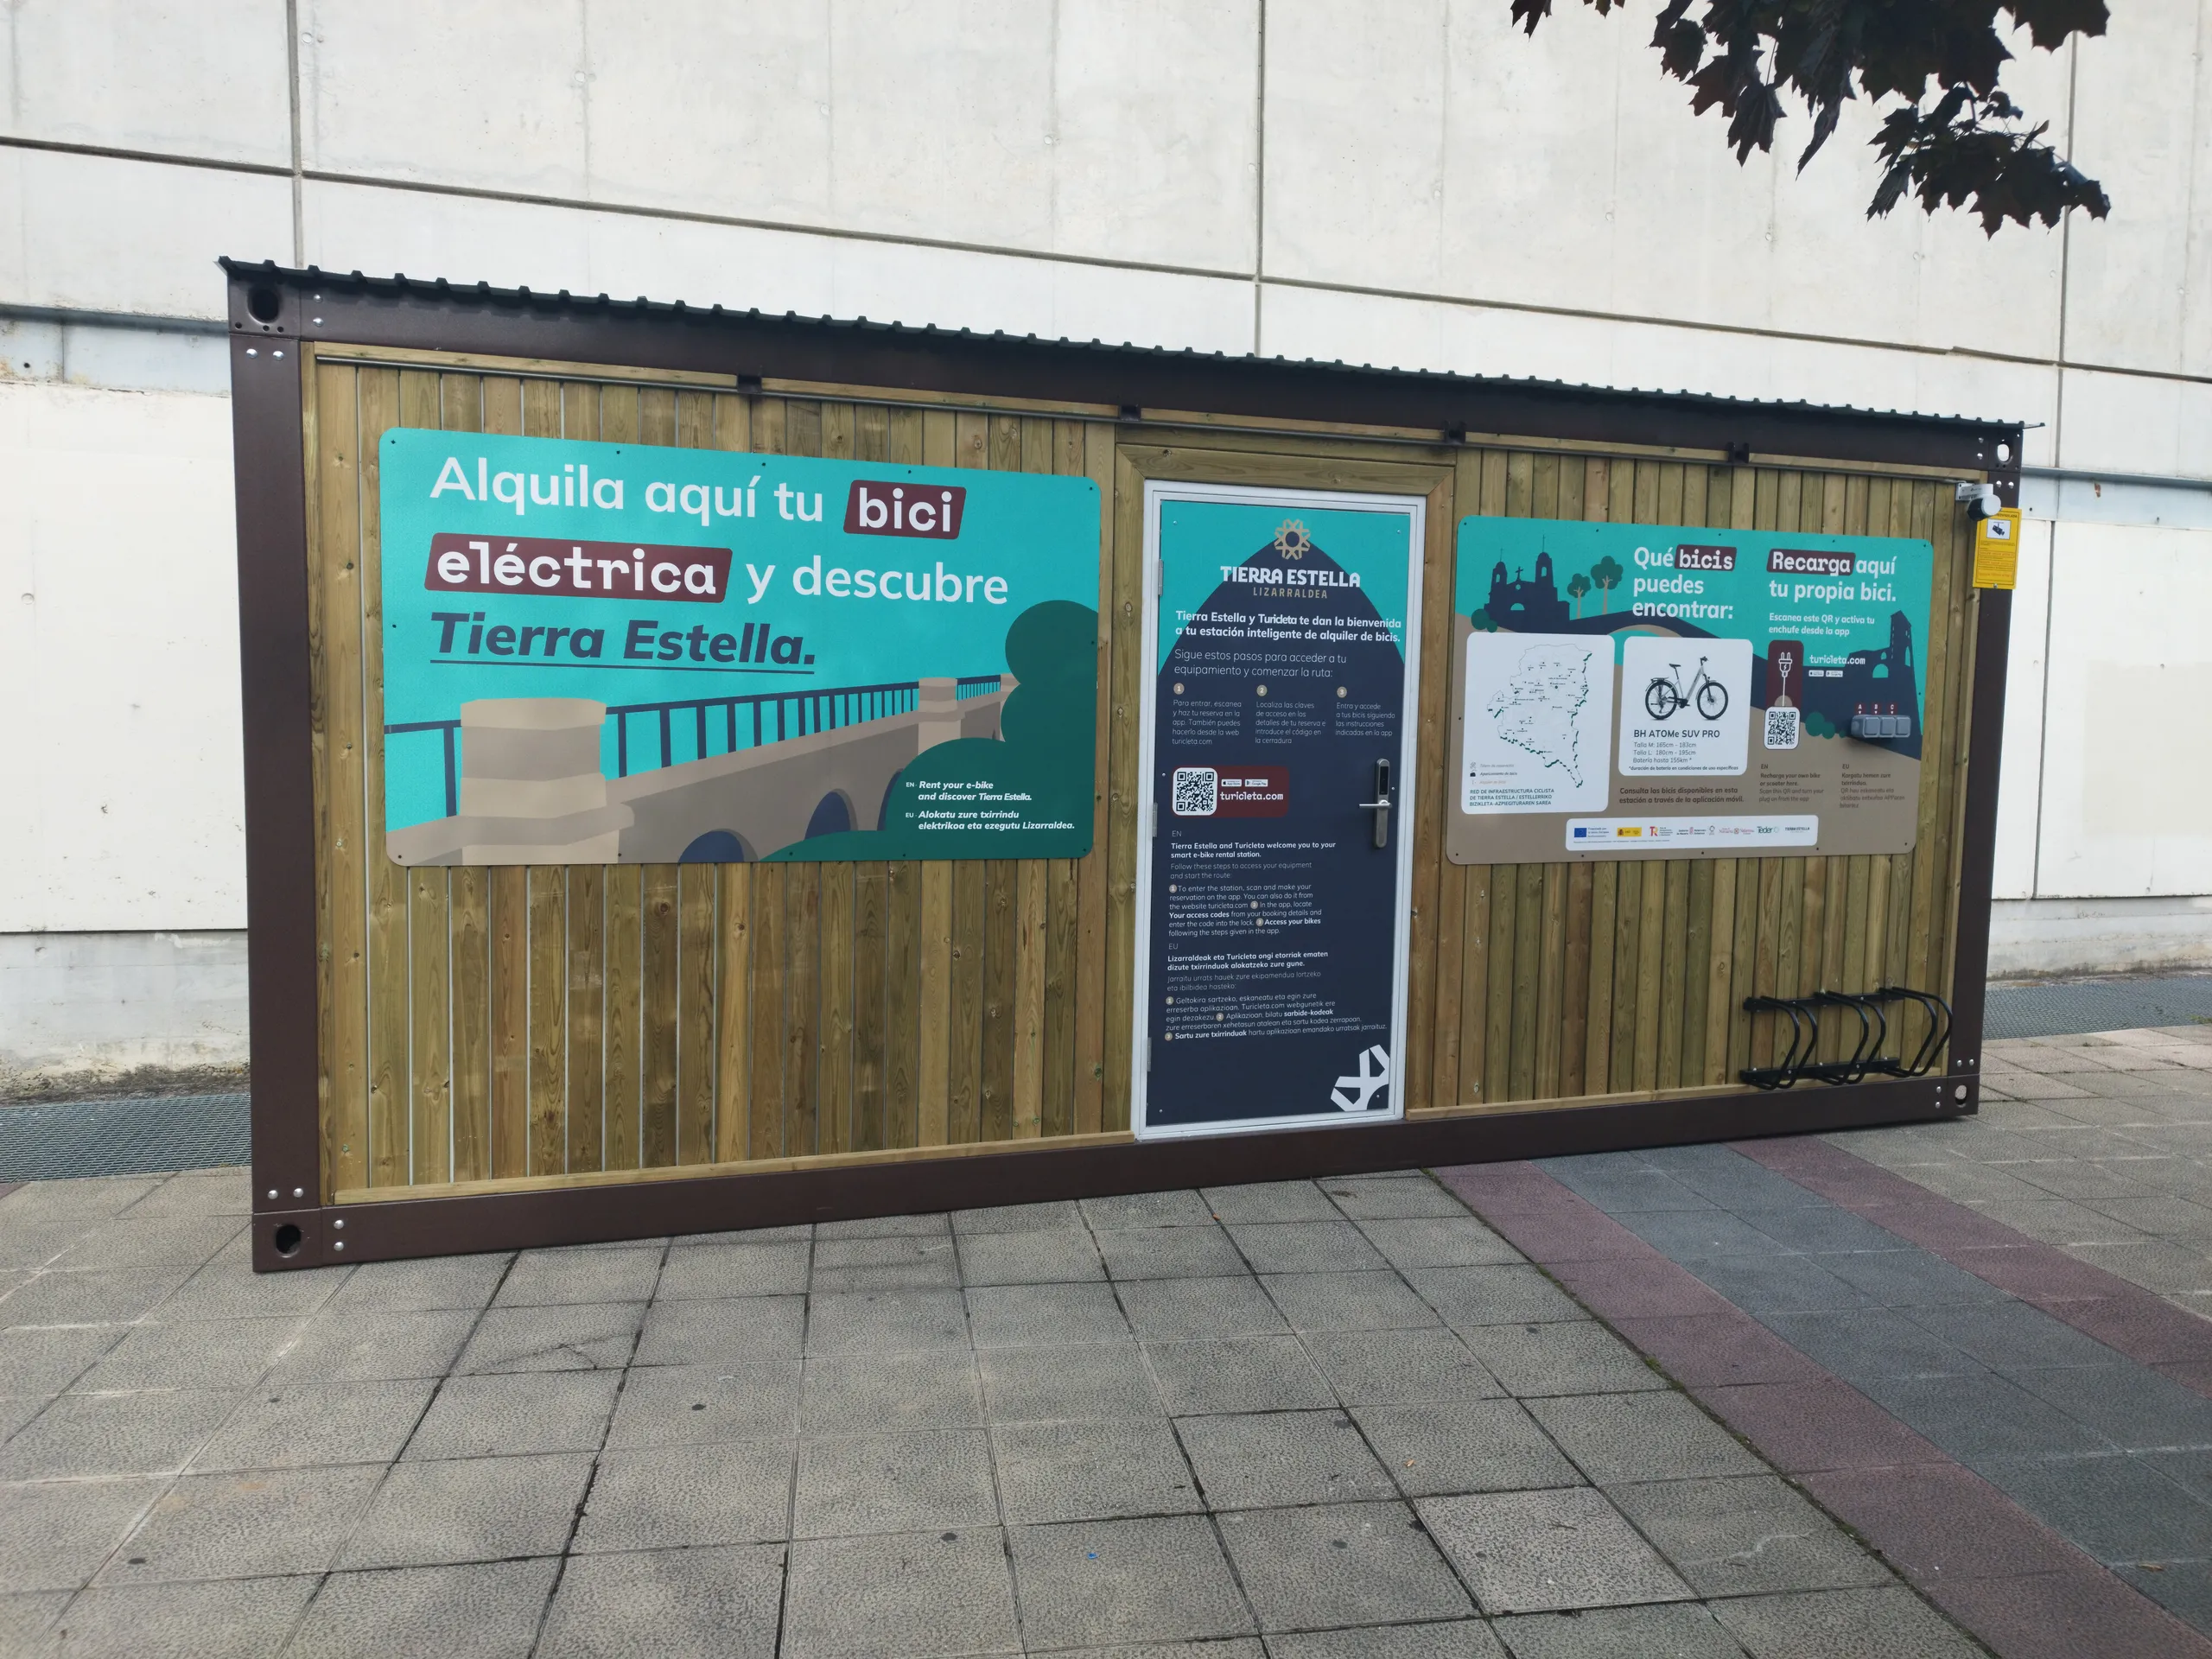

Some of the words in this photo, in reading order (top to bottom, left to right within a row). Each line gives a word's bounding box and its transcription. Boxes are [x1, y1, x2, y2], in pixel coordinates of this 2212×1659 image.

[429, 457, 624, 516] Alquila
[646, 475, 760, 526] aquí
[774, 481, 823, 522] tu
[858, 488, 953, 533] bici
[1634, 546, 1673, 570] Qué
[1680, 549, 1733, 570] bicis
[1773, 552, 1850, 576] Recarga
[1856, 557, 1897, 578] aquí
[437, 542, 716, 594] eléctrica
[746, 563, 774, 604] y
[792, 555, 1008, 605] descubre
[1220, 566, 1282, 583] TIERRA
[1287, 569, 1360, 587] ESTELLA
[1253, 587, 1327, 598] LIZARRALDEA
[1634, 576, 1703, 596] puedes
[1770, 581, 1787, 598] tu
[1795, 583, 1854, 603] propia
[1861, 584, 1896, 601] bici.
[1633, 602, 1733, 618] encontrar:
[1769, 612, 1801, 621] Escanea
[1821, 614, 1833, 623] QR
[1841, 615, 1864, 623] activa
[1175, 610, 1207, 621] Tierra
[1211, 612, 1245, 622] Estella
[1249, 615, 1255, 625] y
[1258, 613, 1297, 624] Turicleta
[1299, 616, 1309, 625] te
[1312, 615, 1331, 625] dan
[1334, 616, 1344, 626] la
[1347, 616, 1401, 627] bienvenida
[1185, 626, 1196, 635] tu
[1199, 626, 1244, 636] estación
[1247, 627, 1301, 640] inteligente
[1304, 629, 1317, 639] de
[1320, 630, 1358, 642] alquiler
[1360, 631, 1372, 641] de
[1375, 631, 1400, 641] bicis.
[1801, 626, 1823, 634] desde
[1825, 626, 1832, 634] la
[431, 612, 603, 659] Tierra
[624, 620, 815, 665] Estella.
[1174, 648, 1202, 661] Sigue
[1204, 651, 1230, 660] estos
[1233, 652, 1262, 662] pasos
[1265, 653, 1287, 663] para
[1289, 653, 1327, 662] acceder
[1337, 654, 1346, 663] tu
[1809, 655, 1865, 664] turicleta.com
[1174, 664, 1241, 676] equipamiento
[1243, 668, 1249, 677] y
[1251, 668, 1298, 676] comenzar
[1301, 667, 1309, 676] la
[1312, 668, 1332, 677] ruta:
[1220, 791, 1283, 800] turicleta.com
[984, 822, 1020, 831] ezegutu
